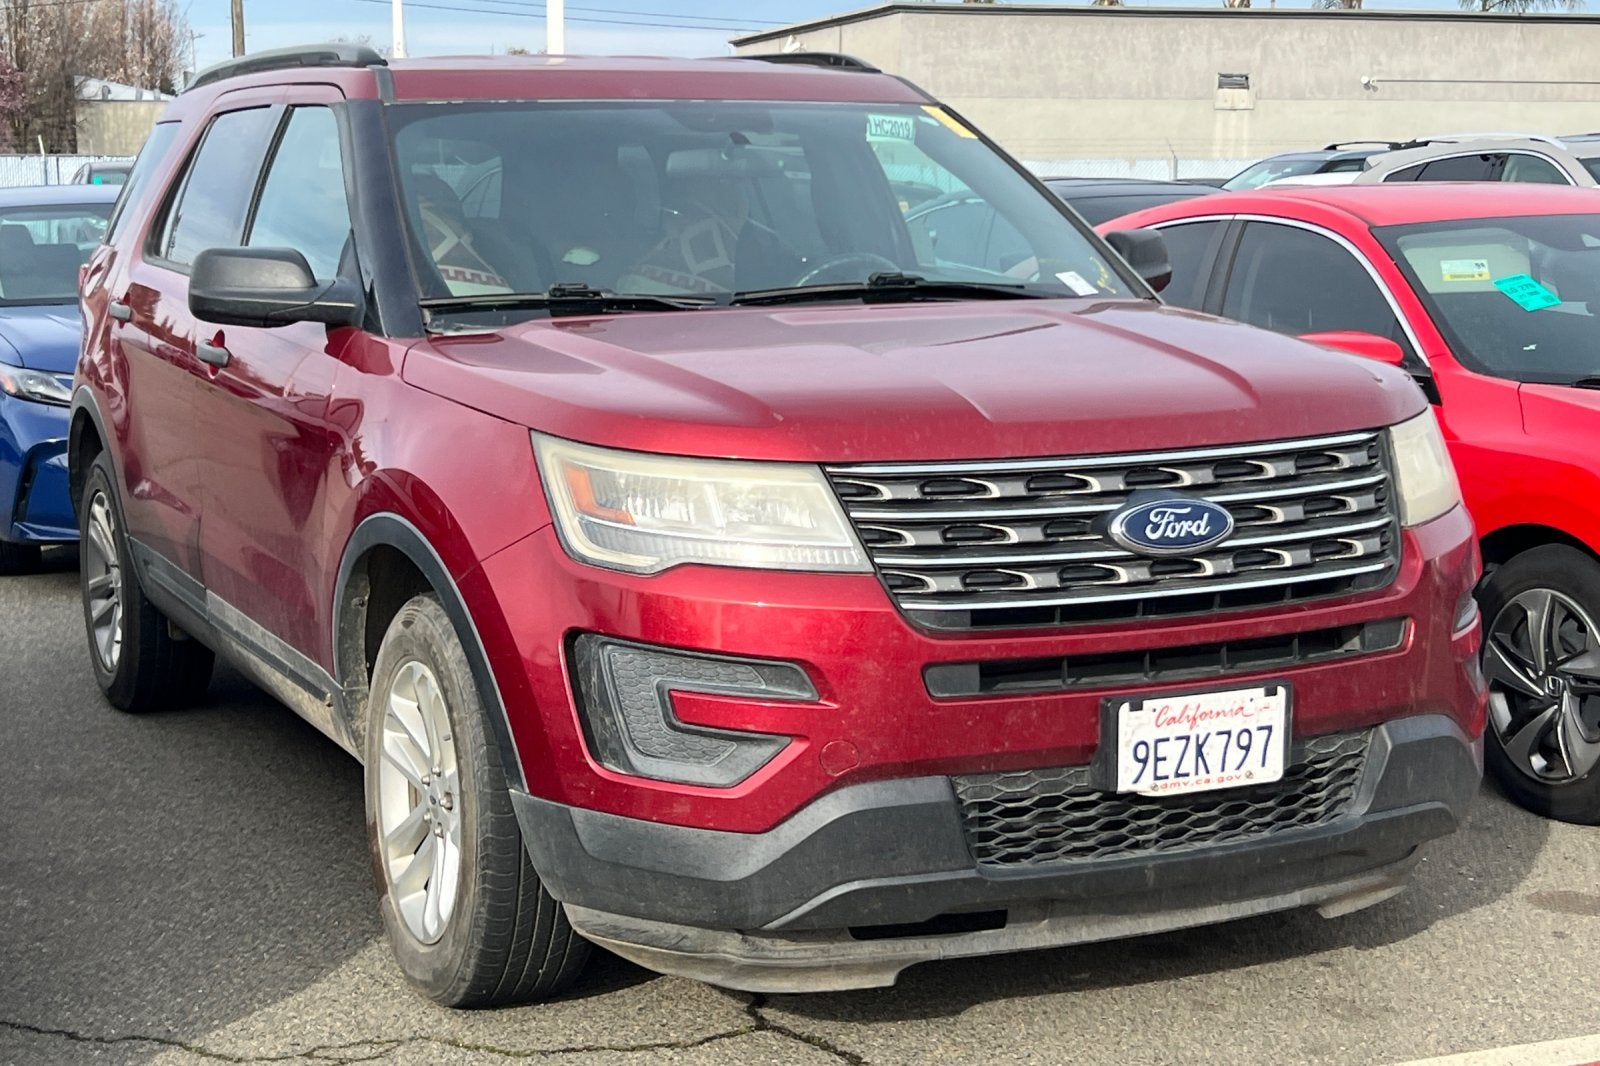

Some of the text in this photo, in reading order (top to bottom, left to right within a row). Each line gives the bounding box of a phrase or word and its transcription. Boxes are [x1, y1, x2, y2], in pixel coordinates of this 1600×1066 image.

[1145, 507, 1211, 540] Ford
[1155, 702, 1254, 730] California
[1132, 724, 1273, 785] 9EZK797
[1160, 773, 1242, 791] dmv.ca.gov
